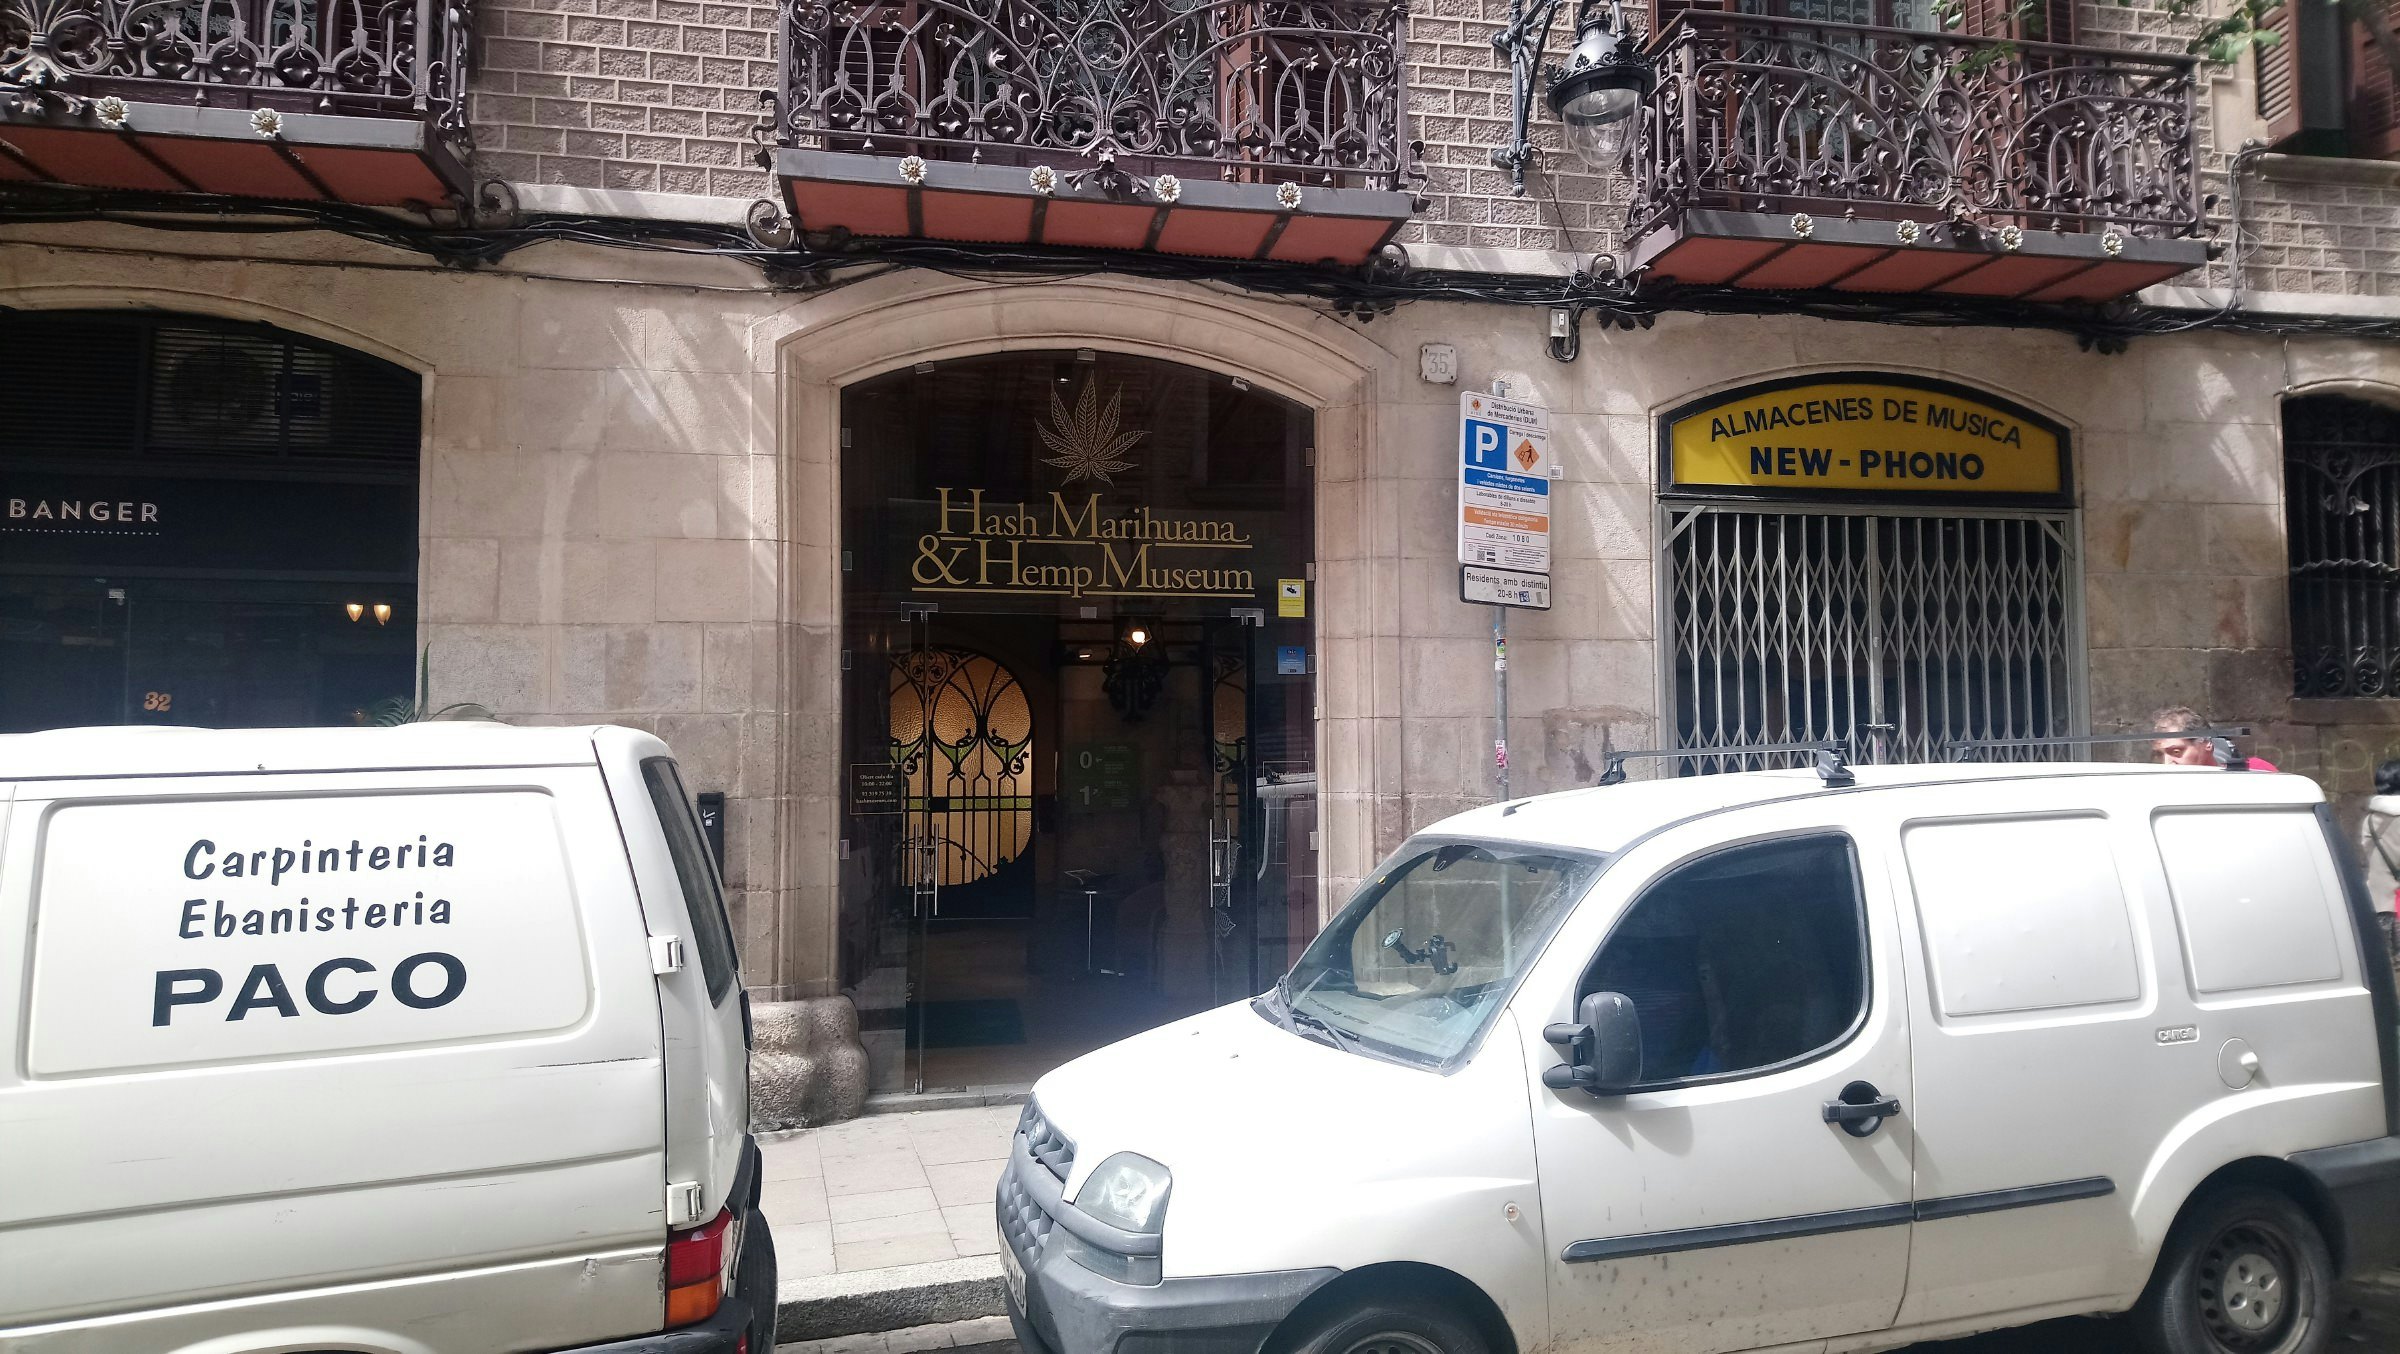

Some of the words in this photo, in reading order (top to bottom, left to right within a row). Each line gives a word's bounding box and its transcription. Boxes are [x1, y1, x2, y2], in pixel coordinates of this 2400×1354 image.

[1518, 406, 1534, 416] Urbana
[1711, 397, 1874, 442] ALMACENES
[1884, 399, 1918, 423] DE
[1926, 407, 2021, 448] MUSICA
[1476, 425, 1498, 463] P
[1750, 446, 1832, 476] NEW
[1860, 449, 1985, 480] PHONO
[9, 498, 158, 523] BANGER
[935, 487, 1040, 536] Hash
[1047, 491, 1250, 542] Marihuana
[912, 534, 969, 585] &
[974, 539, 1093, 598] Hemp
[1098, 542, 1254, 590] Museum
[1466, 572, 1500, 584] Residents
[1503, 578, 1518, 586] amb
[1522, 578, 1548, 590] distintiu
[1497, 589, 1512, 598] 20-8
[1514, 590, 1518, 599] h
[143, 692, 172, 712] 32
[1079, 751, 1092, 769] 0
[184, 834, 454, 886] Carpinteria
[178, 891, 450, 939] Ebanisteria
[152, 952, 467, 1027] PACO
